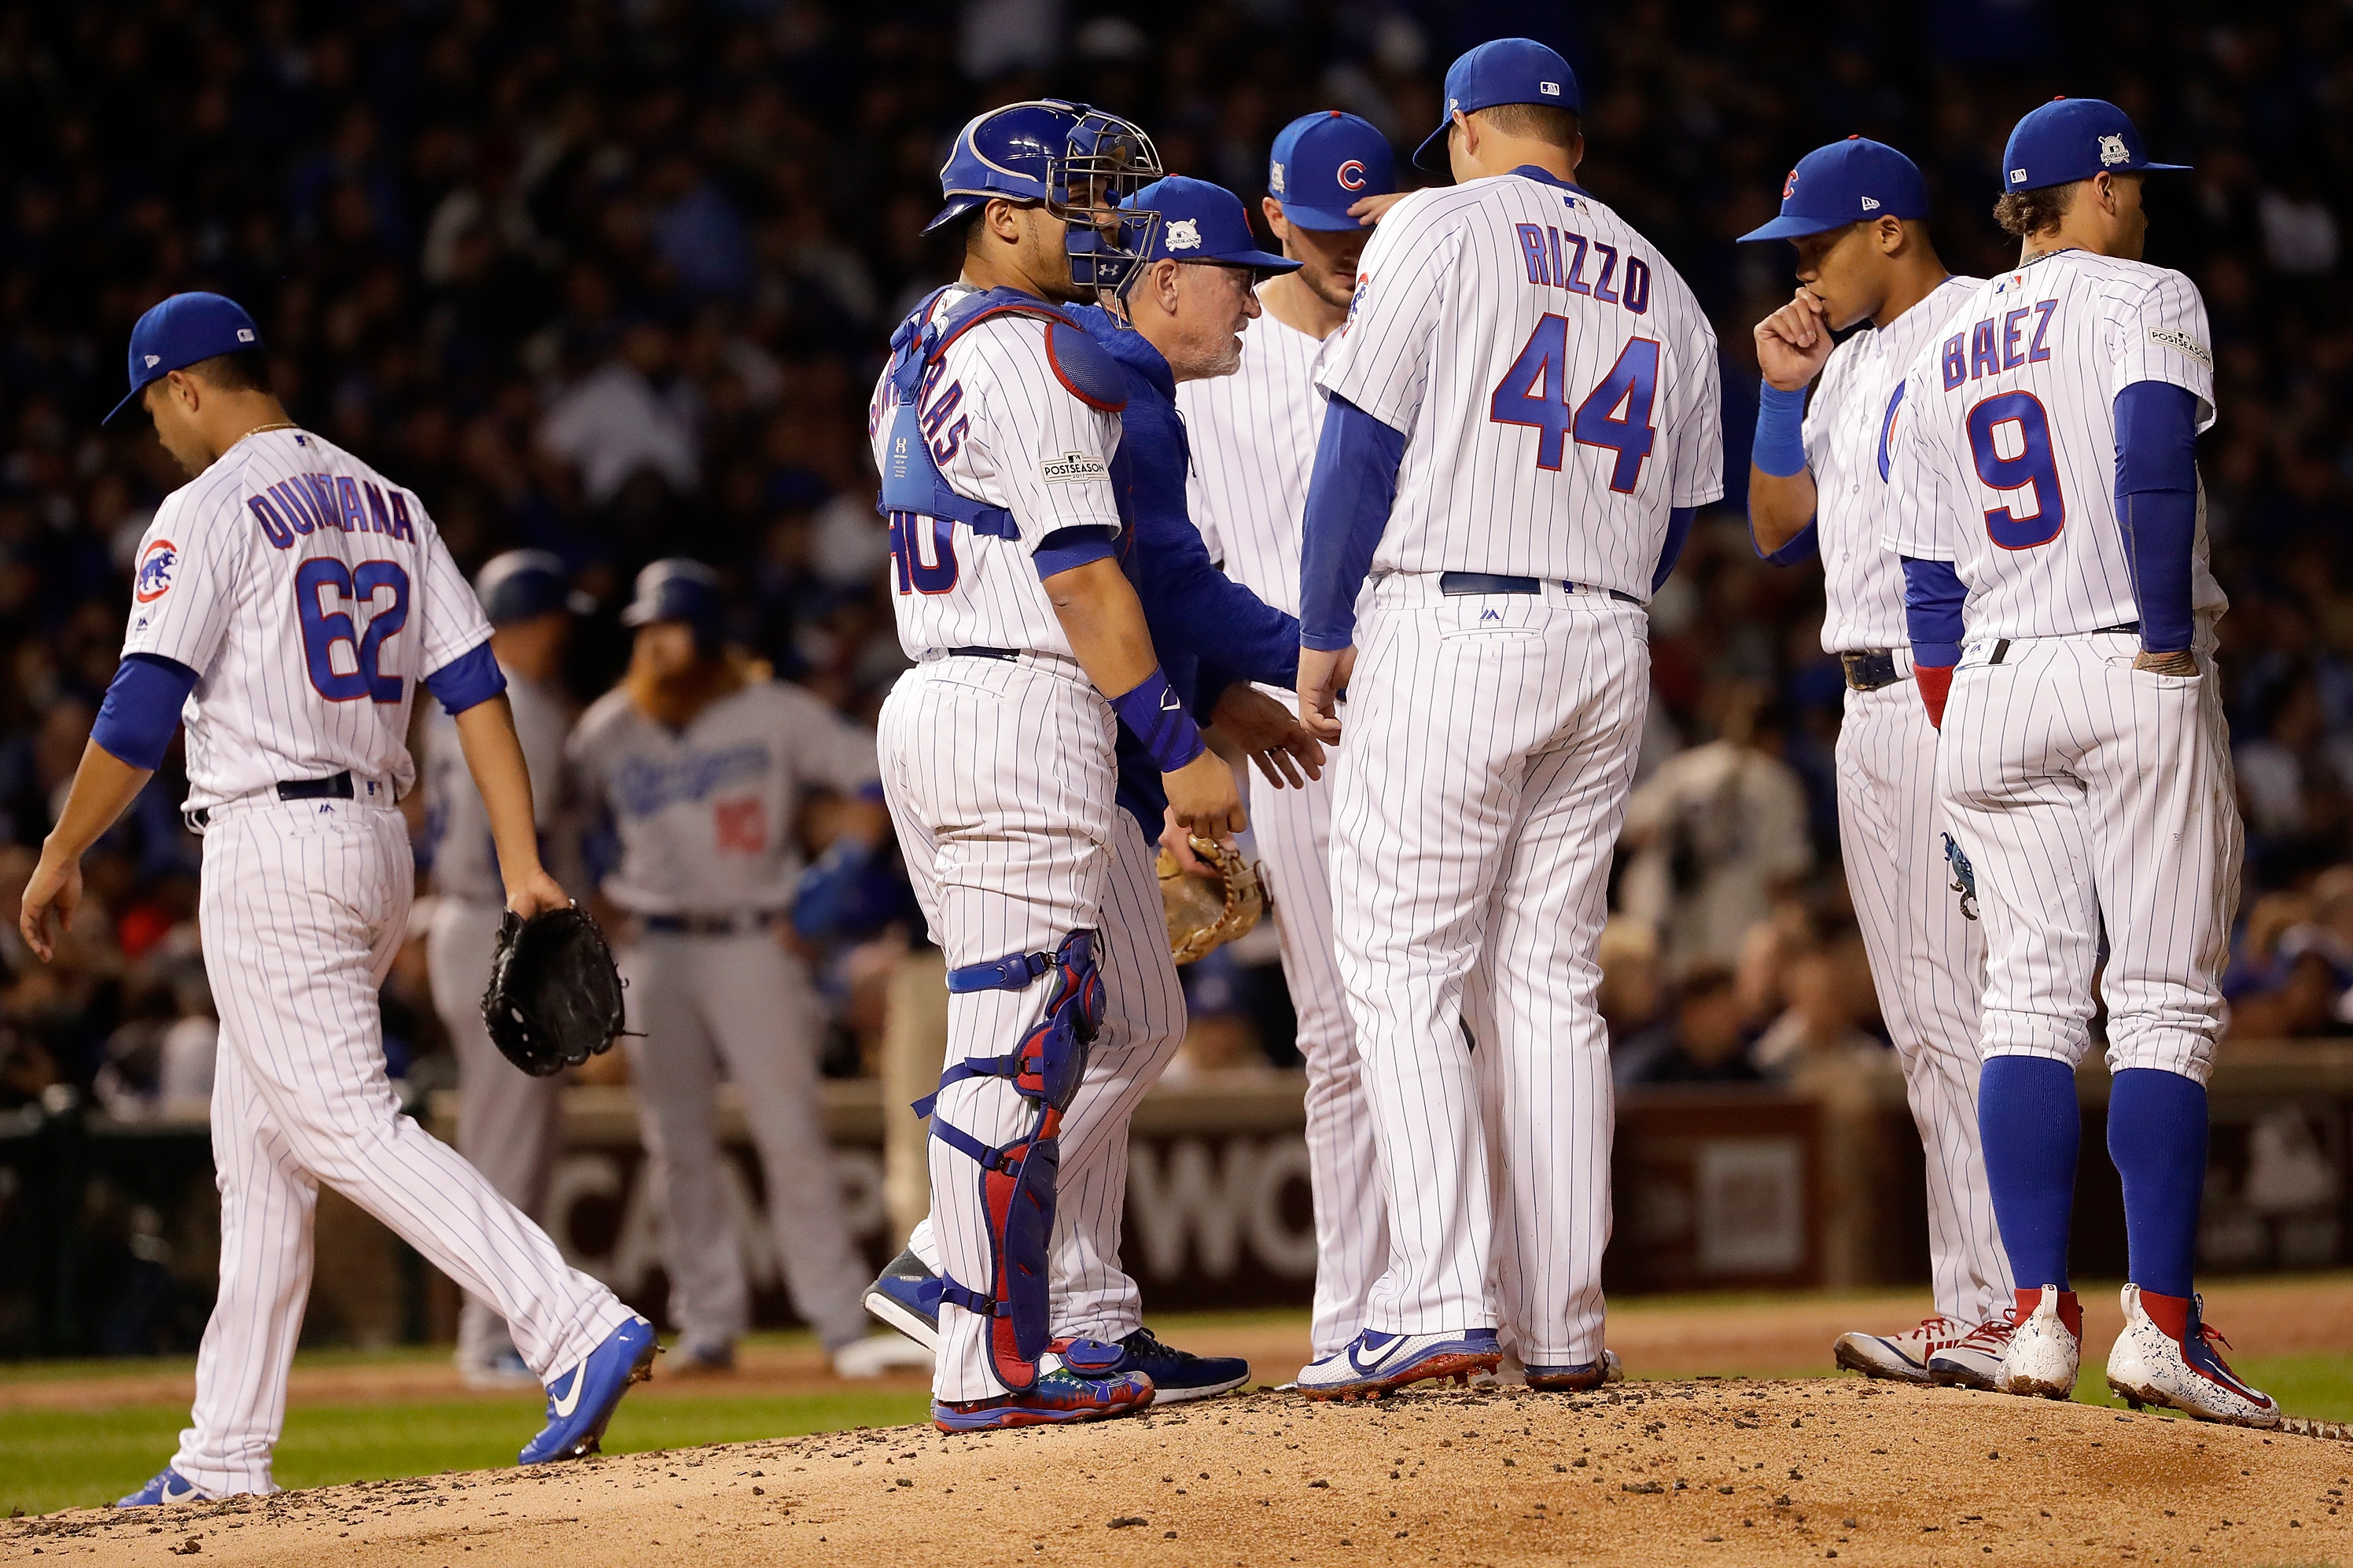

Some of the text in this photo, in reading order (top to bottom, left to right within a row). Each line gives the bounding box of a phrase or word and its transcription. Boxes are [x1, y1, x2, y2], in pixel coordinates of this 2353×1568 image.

[1337, 160, 1366, 191] C
[1515, 223, 1650, 315] RIZZO
[1942, 298, 2059, 392] BAEZ
[2152, 331, 2211, 364] POSTSEASON
[1490, 311, 1660, 494] 44
[247, 473, 416, 550] QUINTANA
[1044, 463, 1105, 476] POSTSEASON
[1966, 389, 2065, 550] 9
[295, 557, 411, 704] 62
